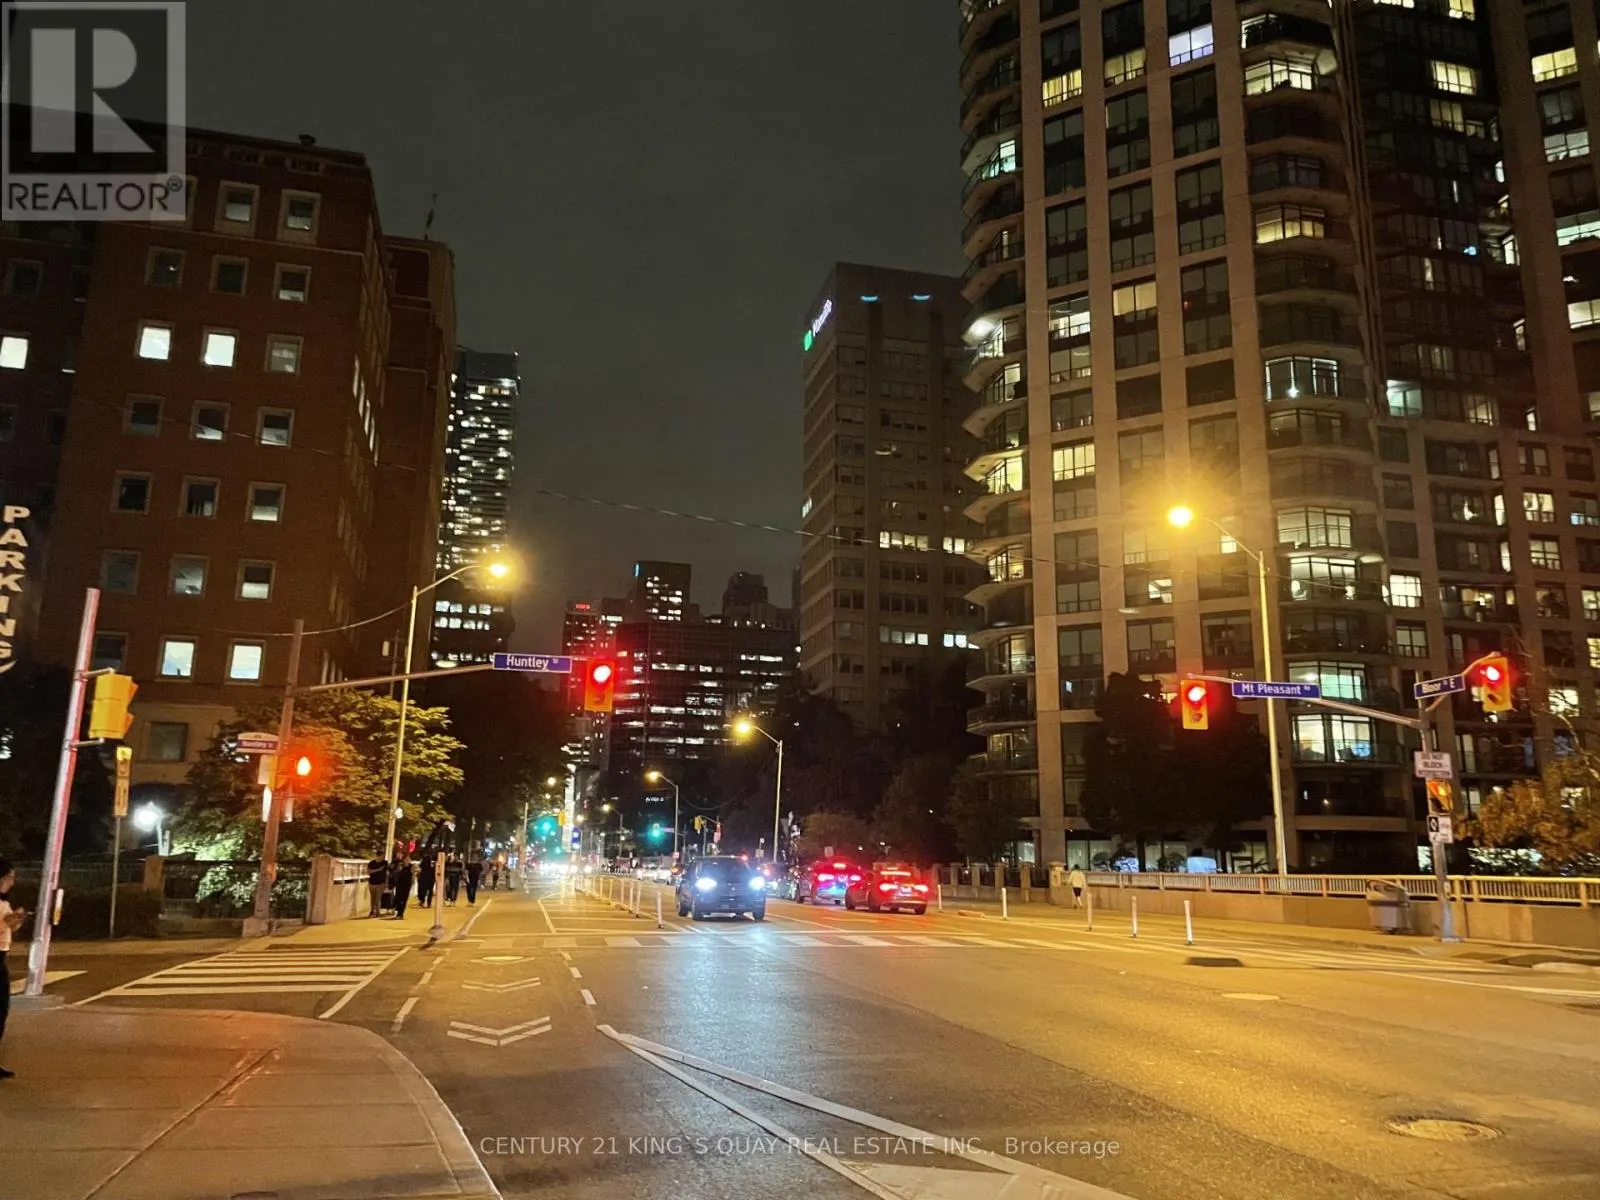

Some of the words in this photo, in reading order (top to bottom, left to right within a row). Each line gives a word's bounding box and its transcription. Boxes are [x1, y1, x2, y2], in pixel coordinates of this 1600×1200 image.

[506, 655, 549, 670] Huntley
[1241, 683, 1254, 694] Mt
[1258, 683, 1302, 695] Pleasant
[1450, 677, 1456, 689] E
